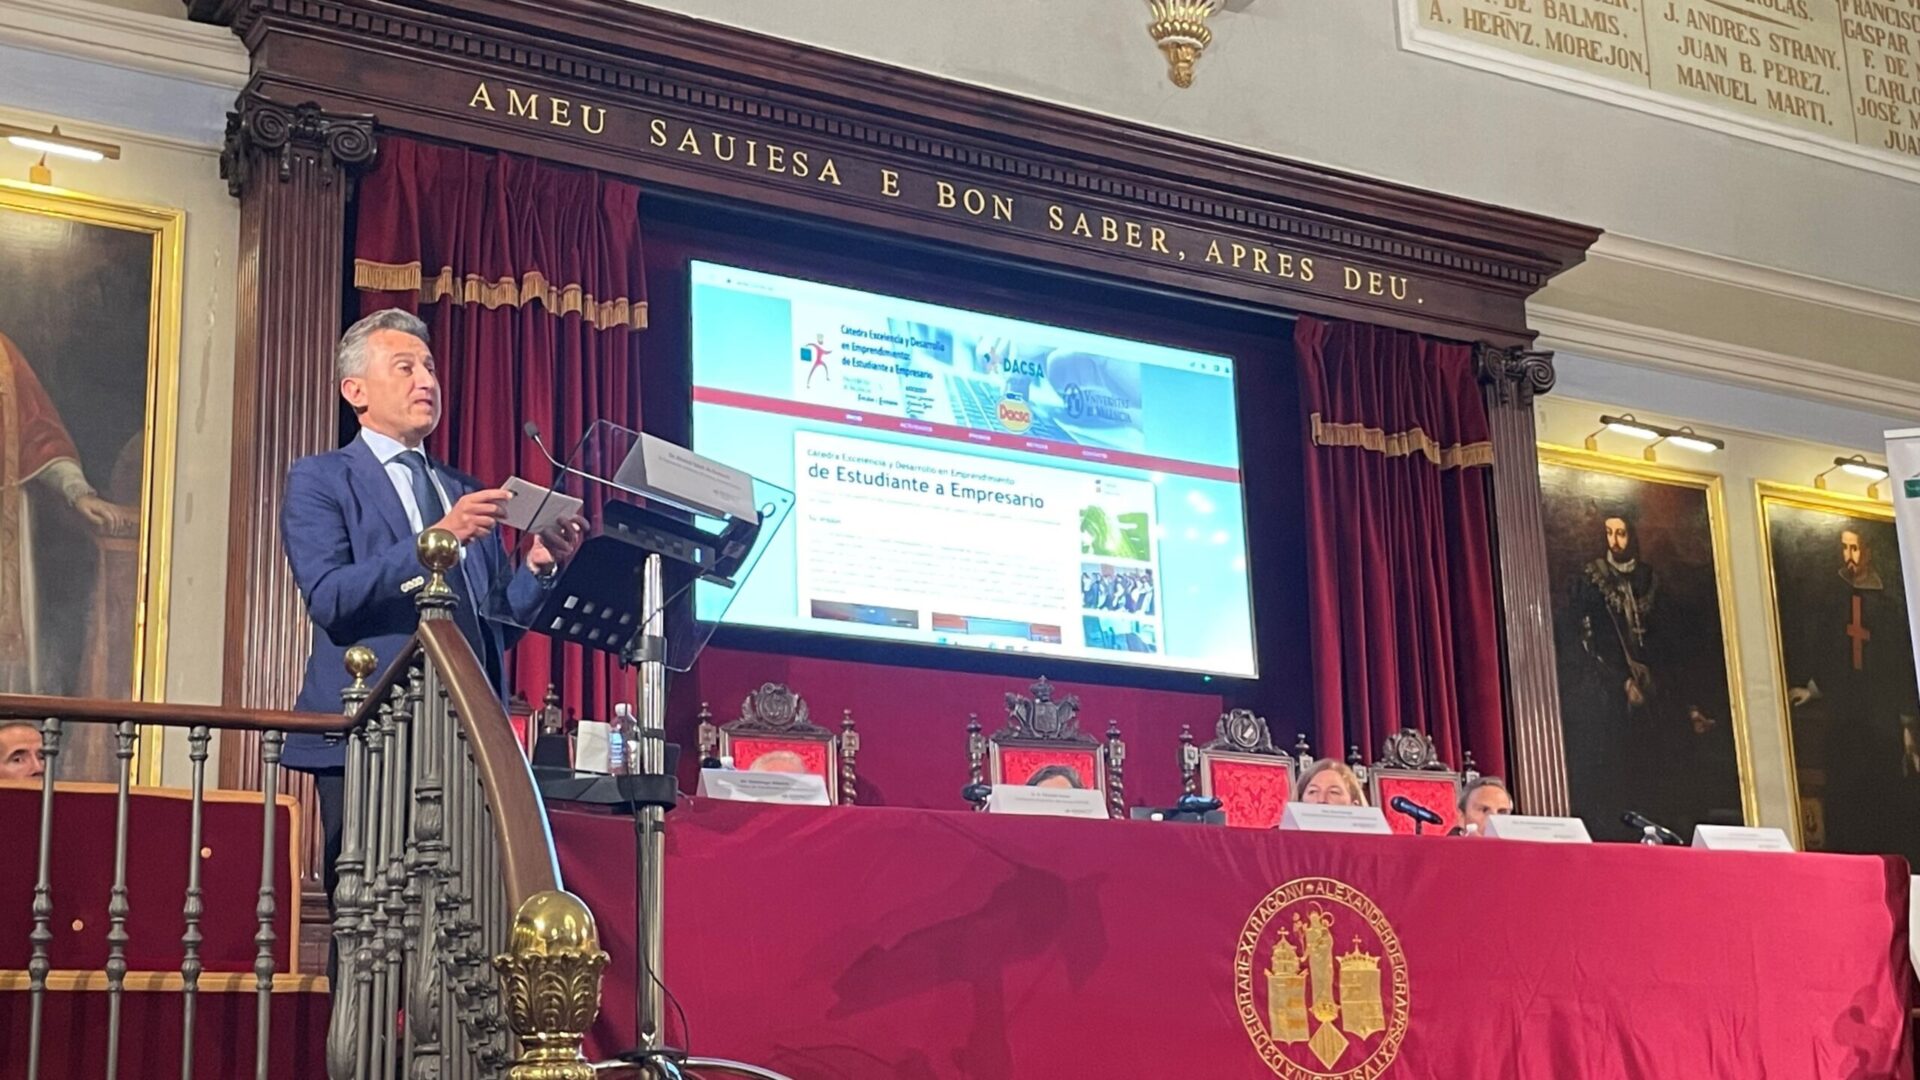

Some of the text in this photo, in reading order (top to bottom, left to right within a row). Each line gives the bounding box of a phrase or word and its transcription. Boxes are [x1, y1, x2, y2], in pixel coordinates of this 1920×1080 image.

[1429, 0, 1452, 24] A.
[1545, 28, 1650, 76] MOREJON.
[1544, 0, 1627, 39] BALMIS.
[1663, 2, 1841, 71] J. ANDRES STRANY.
[1843, 19, 1911, 56] GASPAR
[1678, 36, 1831, 96] JUAN B. PEREZ.
[1884, 54, 1909, 78] DE
[1676, 64, 1833, 126] MANUEL MARTI.
[1884, 129, 1920, 156] JUA
[468, 82, 1425, 305] AMEU SAUIESA E BON SABER, APRES DEU.
[1003, 357, 1045, 379] DACSA
[999, 403, 1031, 423] Dacsa
[842, 453, 887, 467] Excelencia
[895, 461, 937, 474] Desarrollo
[808, 462, 830, 479] de
[836, 465, 930, 493] Estudiante
[935, 483, 945, 496] a
[950, 482, 1044, 509] Empresario
